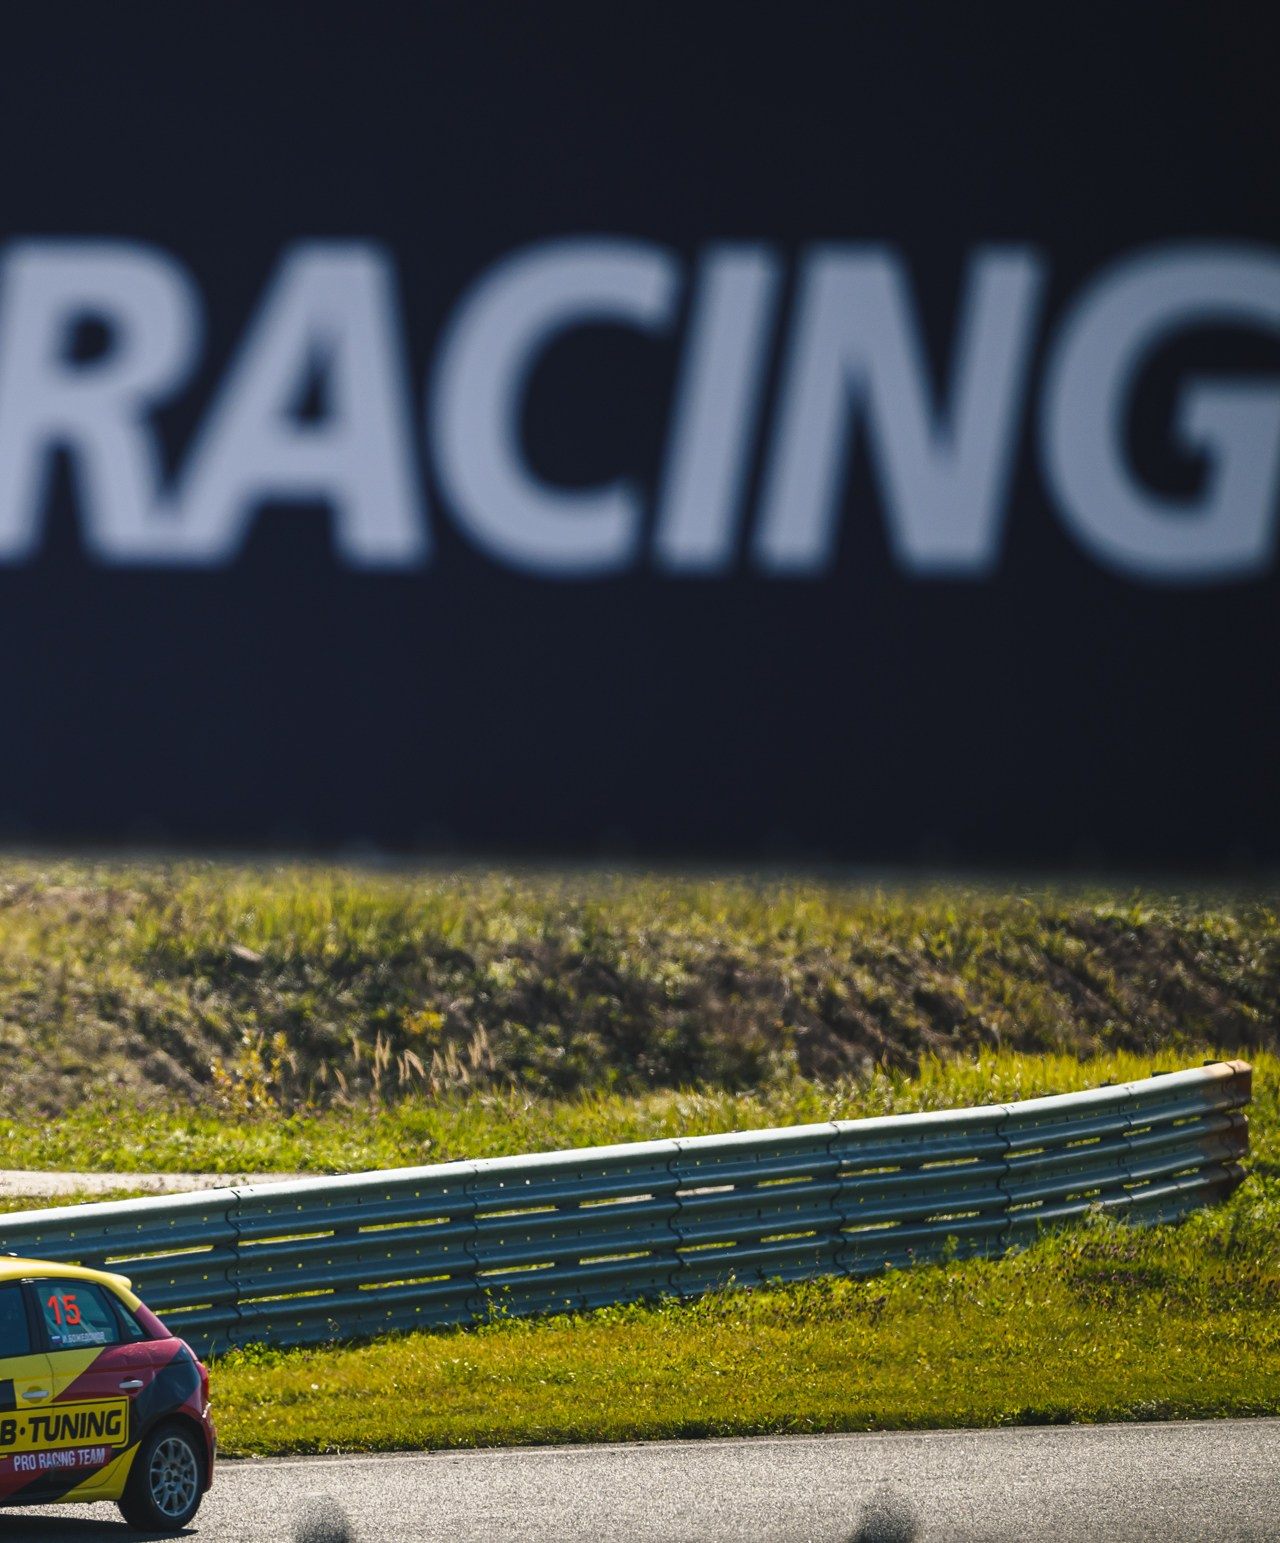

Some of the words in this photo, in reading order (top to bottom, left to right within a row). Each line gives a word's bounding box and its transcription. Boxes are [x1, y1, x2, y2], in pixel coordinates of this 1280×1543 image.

[47, 1295, 81, 1325] 15
[13, 1455, 36, 1471] PRO
[39, 1451, 75, 1469] RACING
[77, 1448, 105, 1465] TEAM
